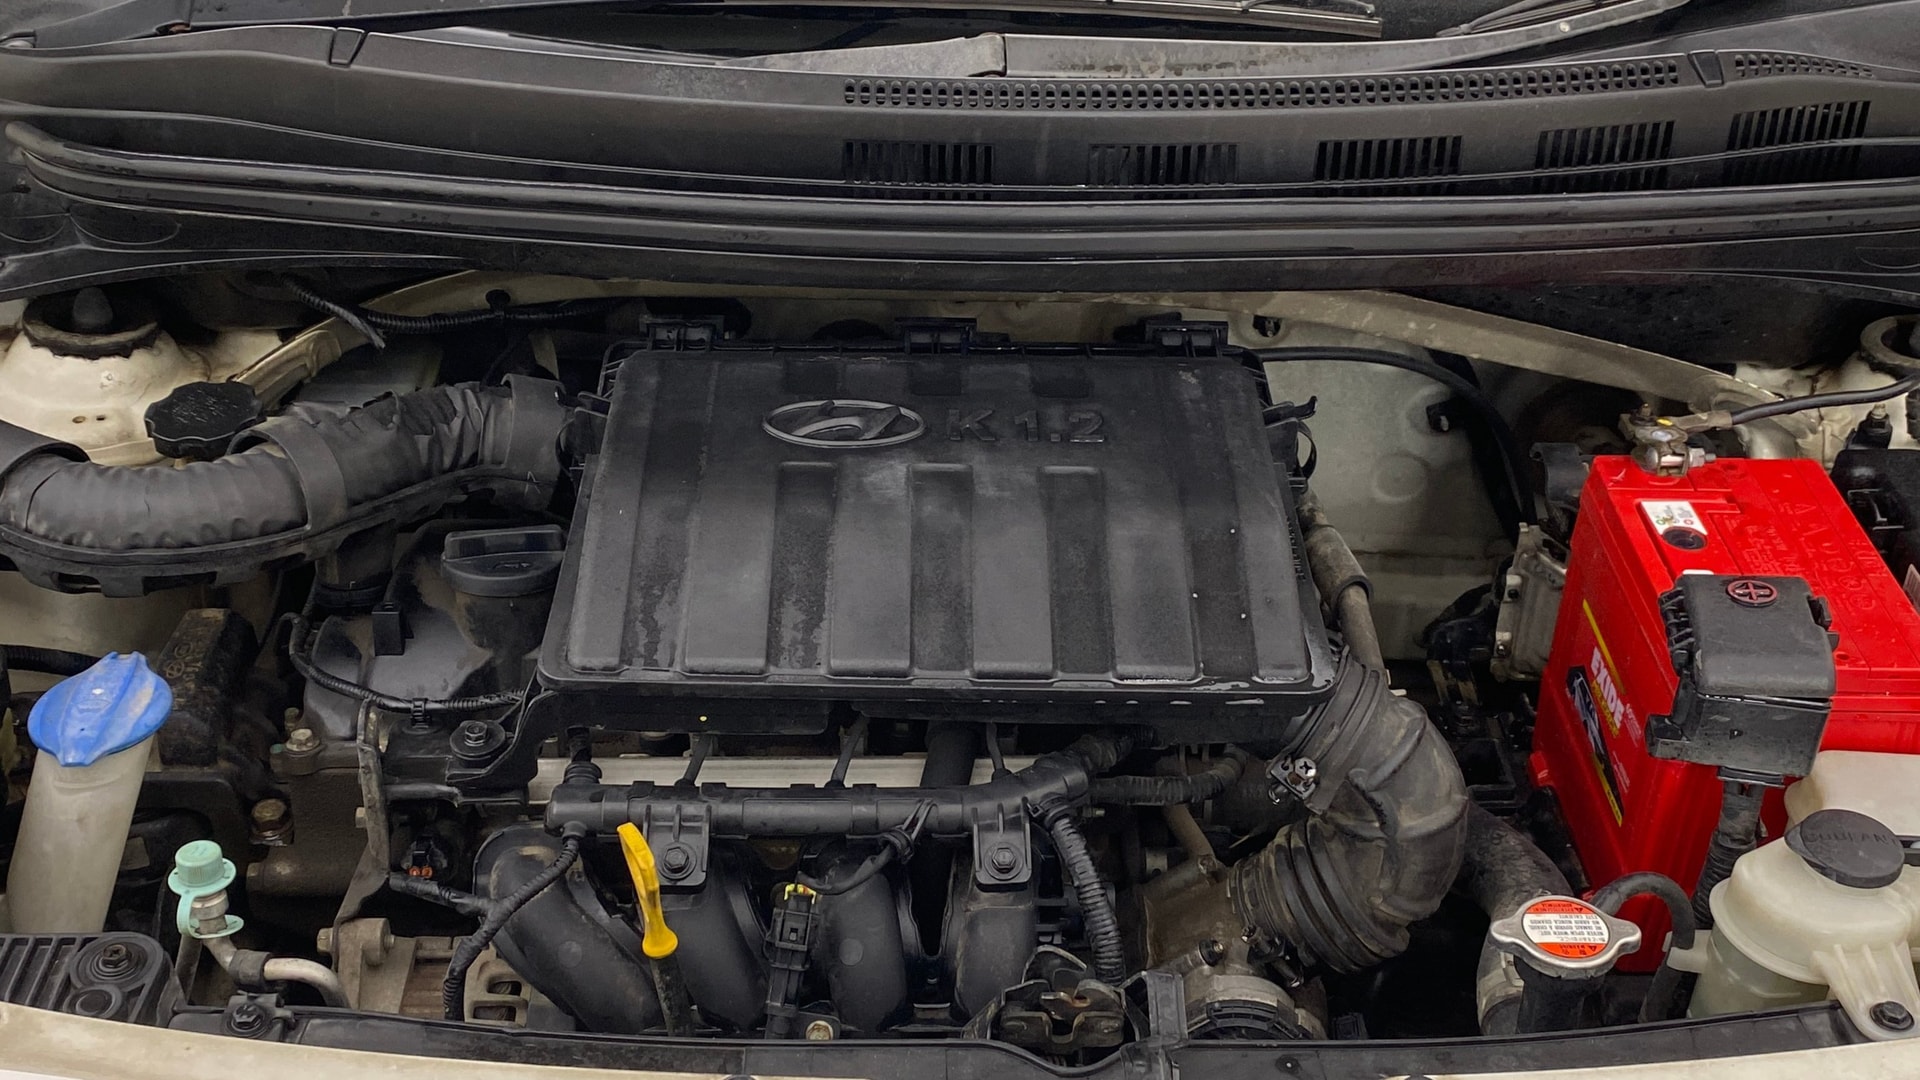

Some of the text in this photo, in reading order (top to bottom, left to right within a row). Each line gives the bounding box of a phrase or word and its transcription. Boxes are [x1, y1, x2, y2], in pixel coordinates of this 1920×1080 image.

[946, 408, 1105, 443] K 1.2
[1590, 646, 1625, 729] EXIDE
